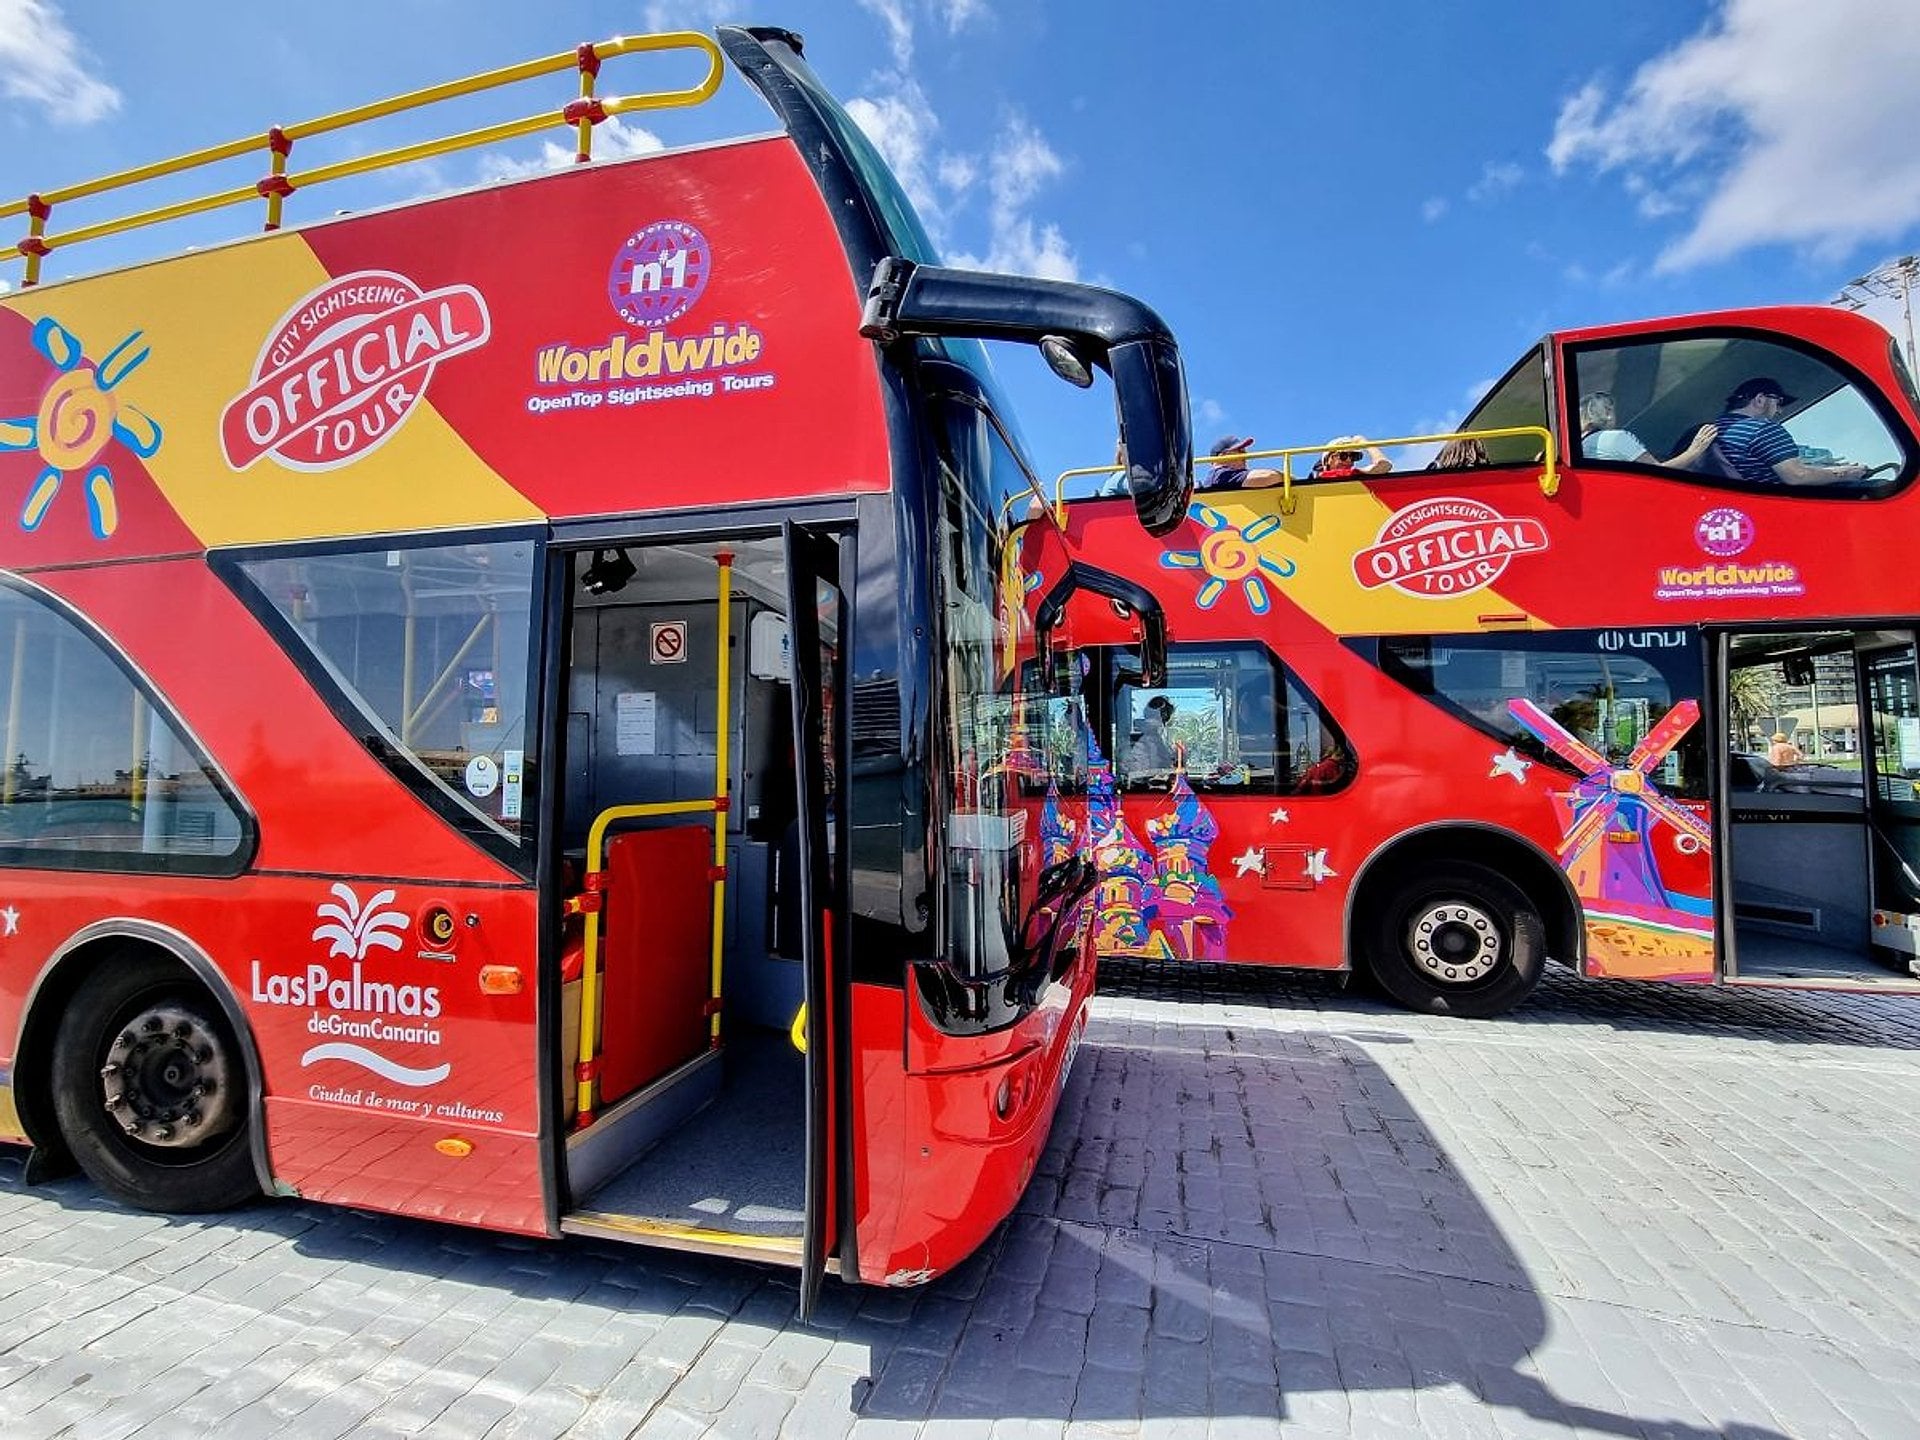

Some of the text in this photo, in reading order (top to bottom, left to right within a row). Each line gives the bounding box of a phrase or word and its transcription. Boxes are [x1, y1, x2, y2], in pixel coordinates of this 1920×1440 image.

[271, 286, 407, 369] CITY SIGHTSEEING
[538, 325, 760, 383] Worldwide
[246, 302, 470, 446] OFFICIAL
[527, 374, 775, 413] OpenTop Sightseeing Tours
[314, 383, 415, 455] TOUR
[1371, 523, 1536, 580] OFFICIAL
[1423, 561, 1497, 592] TOUR
[1661, 563, 1794, 586] Worldwide
[251, 959, 442, 1018] LasPalmas
[307, 1011, 441, 1045] deGranCanaria
[308, 1084, 504, 1123] Ciudad de mar y culturas
